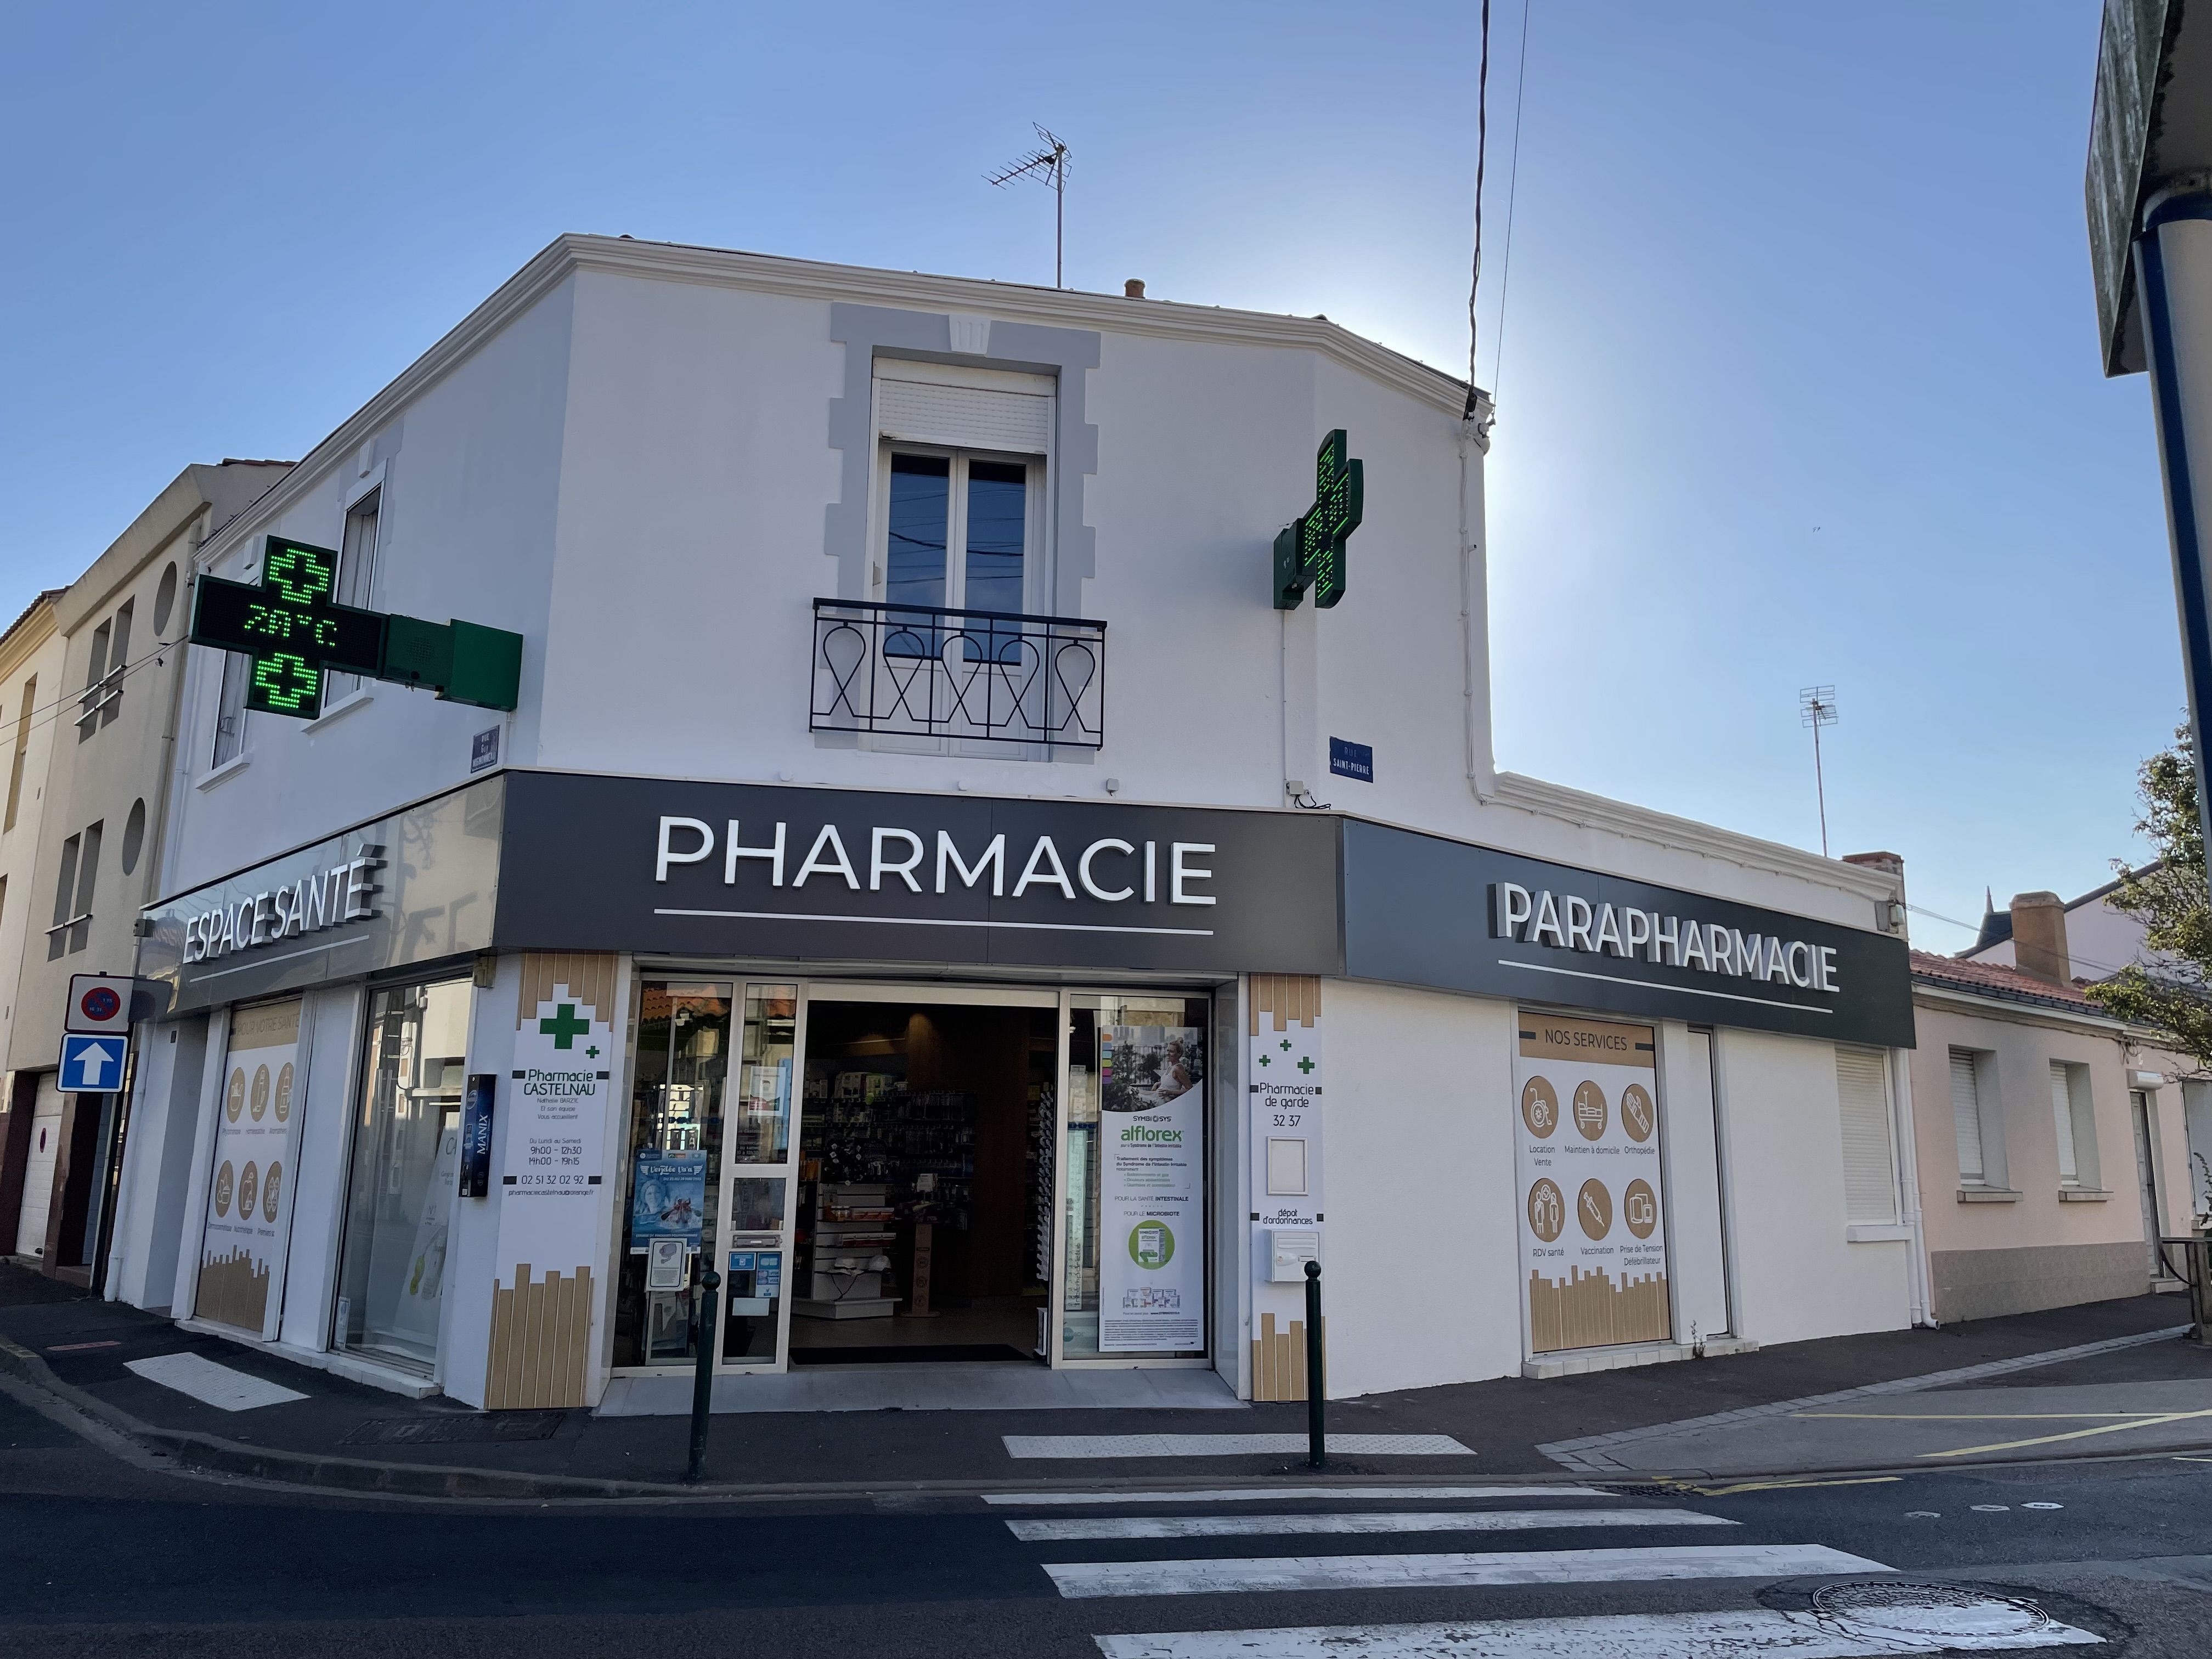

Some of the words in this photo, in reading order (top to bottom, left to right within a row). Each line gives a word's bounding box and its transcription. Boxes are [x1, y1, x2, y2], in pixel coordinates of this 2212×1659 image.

[1345, 747, 1357, 757] RUE
[1333, 758, 1369, 775] SAINT-PIERRE
[655, 815, 1216, 905] PHARMACIE
[183, 891, 274, 964] ESPACE
[271, 843, 377, 939] SANTÉ
[1496, 881, 1840, 992] PARAPHARMACIE
[1545, 1028, 1571, 1046] NOS
[1573, 1031, 1628, 1051] SERVICES
[528, 1069, 594, 1082] Pharmacie
[523, 1083, 596, 1096] CASTELNAU
[1260, 1082, 1314, 1095] Pharmacie
[1265, 1096, 1277, 1107] de
[1280, 1096, 1309, 1109] garde
[1273, 1115, 1285, 1126] 32
[1288, 1115, 1301, 1126] 37
[477, 1114, 488, 1154] MANIX
[1121, 1125, 1182, 1142] alflorex
[531, 1146, 551, 1154] 9h00
[561, 1146, 582, 1155] 12h30
[1529, 1144, 1555, 1154] Location
[1564, 1145, 1590, 1154] Maintien
[1591, 1145, 1595, 1154] à
[1595, 1146, 1620, 1154] domicile
[1624, 1146, 1655, 1155] Orthopédie
[529, 1157, 551, 1165] 14h00
[561, 1157, 580, 1165] 19h15
[1534, 1158, 1552, 1166] Vente
[521, 1175, 533, 1184] 02
[535, 1176, 544, 1184] 51
[546, 1176, 556, 1184] 32
[559, 1176, 571, 1184] 02
[573, 1176, 584, 1184] 92
[1263, 1216, 1313, 1224] d'ordonnances
[1533, 1249, 1547, 1257] RDV
[1548, 1247, 1565, 1256] santé
[1581, 1246, 1614, 1255] Vaccination
[1620, 1245, 1634, 1253] Prise
[1643, 1244, 1663, 1252] Tension
